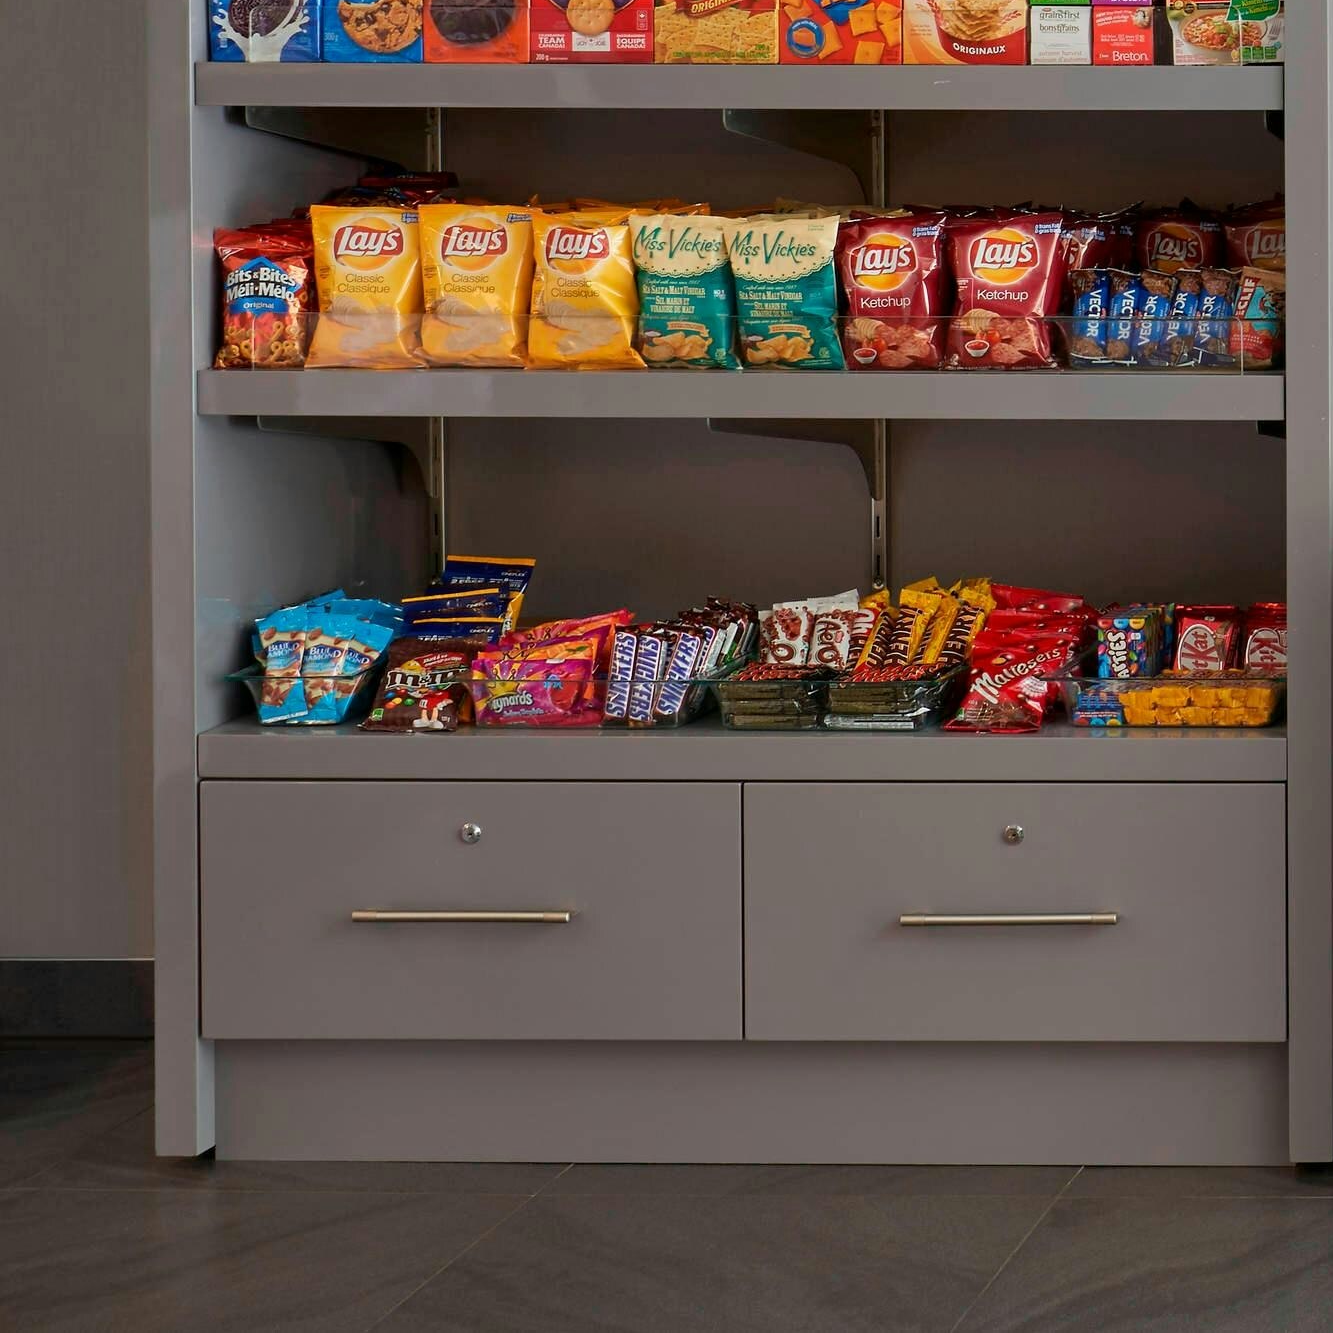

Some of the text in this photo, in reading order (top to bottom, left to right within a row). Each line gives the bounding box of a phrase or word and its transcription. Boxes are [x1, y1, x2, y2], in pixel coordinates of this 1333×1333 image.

[953, 43, 1006, 55] ORIGINAUX
[1113, 51, 1149, 62] Breton
[338, 225, 400, 256] Lay's
[445, 226, 504, 257] Lay's
[549, 227, 604, 259] Lay's
[634, 225, 721, 259] Miss Vickie's
[729, 230, 816, 265] Miss Vickie's
[1152, 233, 1198, 262] Lay's
[973, 239, 1033, 269] Lay's
[855, 245, 912, 277] Lay's
[226, 267, 296, 286] Bits Bites
[346, 273, 384, 283] Classic
[452, 273, 489, 283] Classic
[557, 277, 592, 287] Classic
[338, 282, 390, 294] Classique
[444, 282, 495, 294] Classique
[551, 287, 600, 298] Classique
[651, 284, 663, 294] SALT
[669, 285, 684, 295] MALT
[977, 290, 1029, 302] Ketchup
[243, 302, 274, 310] Original
[861, 297, 911, 309] Ketchup
[969, 647, 1061, 705] Maltesers
